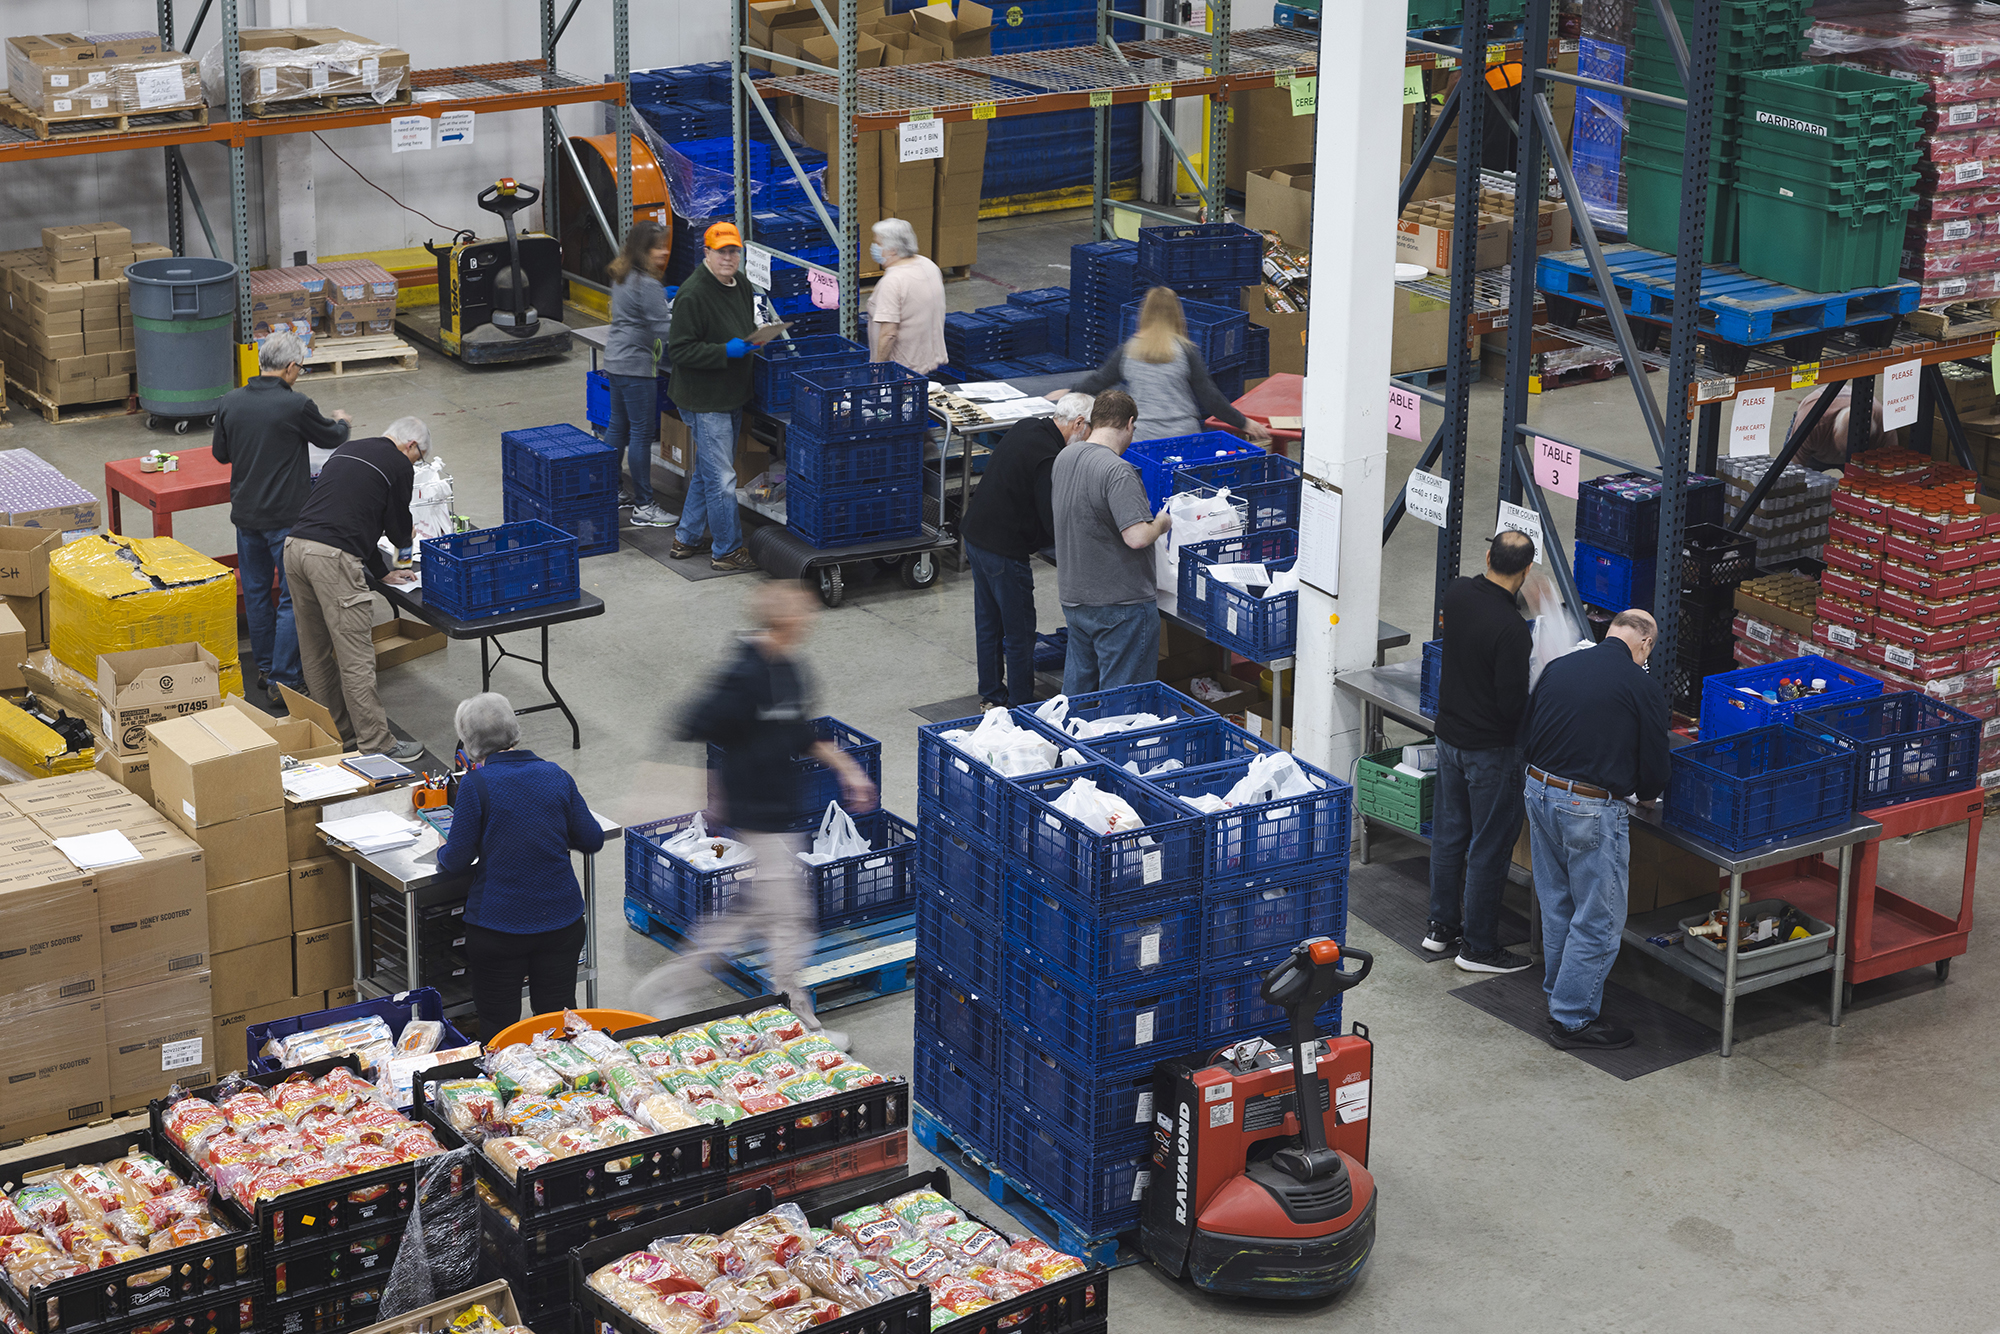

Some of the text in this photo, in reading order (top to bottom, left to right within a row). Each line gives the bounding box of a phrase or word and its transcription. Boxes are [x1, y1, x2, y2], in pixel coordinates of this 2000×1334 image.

[1306, 81, 1311, 93] 1
[1760, 112, 1825, 136] CARDBOARD
[1401, 235, 1415, 243] doers
[820, 292, 824, 304] 1
[1891, 368, 1913, 381] PLEASE
[1389, 391, 1413, 411] ABLE
[1742, 396, 1766, 407] PLEASE
[1887, 393, 1915, 406] PARK CARTS
[1895, 405, 1906, 414] HERE
[1394, 415, 1402, 430] 2
[1750, 423, 1766, 431] CARTS
[1743, 434, 1756, 442] HERE
[1542, 443, 1572, 465] TABLE
[1415, 472, 1442, 488] ITEM COUNT
[1552, 469, 1559, 485] 3
[1411, 486, 1423, 497] <=40
[1433, 494, 1444, 504] BIN
[74, 510, 95, 520] Totally
[1410, 503, 1419, 511] 41+
[1429, 508, 1442, 521] BINS
[1508, 506, 1538, 522] ITEM COUNT
[1529, 528, 1540, 539] BIN
[0, 568, 20, 578] SH
[178, 700, 208, 713] 07495
[299, 871, 309, 879] JA
[140, 916, 159, 926] HONEY
[30, 941, 49, 951] HONEY
[305, 936, 315, 945] JA
[221, 1018, 231, 1026] JA
[148, 1036, 167, 1046] HONEY
[38, 1065, 58, 1075] HONEY
[1342, 1071, 1361, 1084] ACR
[1176, 1102, 1190, 1226] RAYMOND
